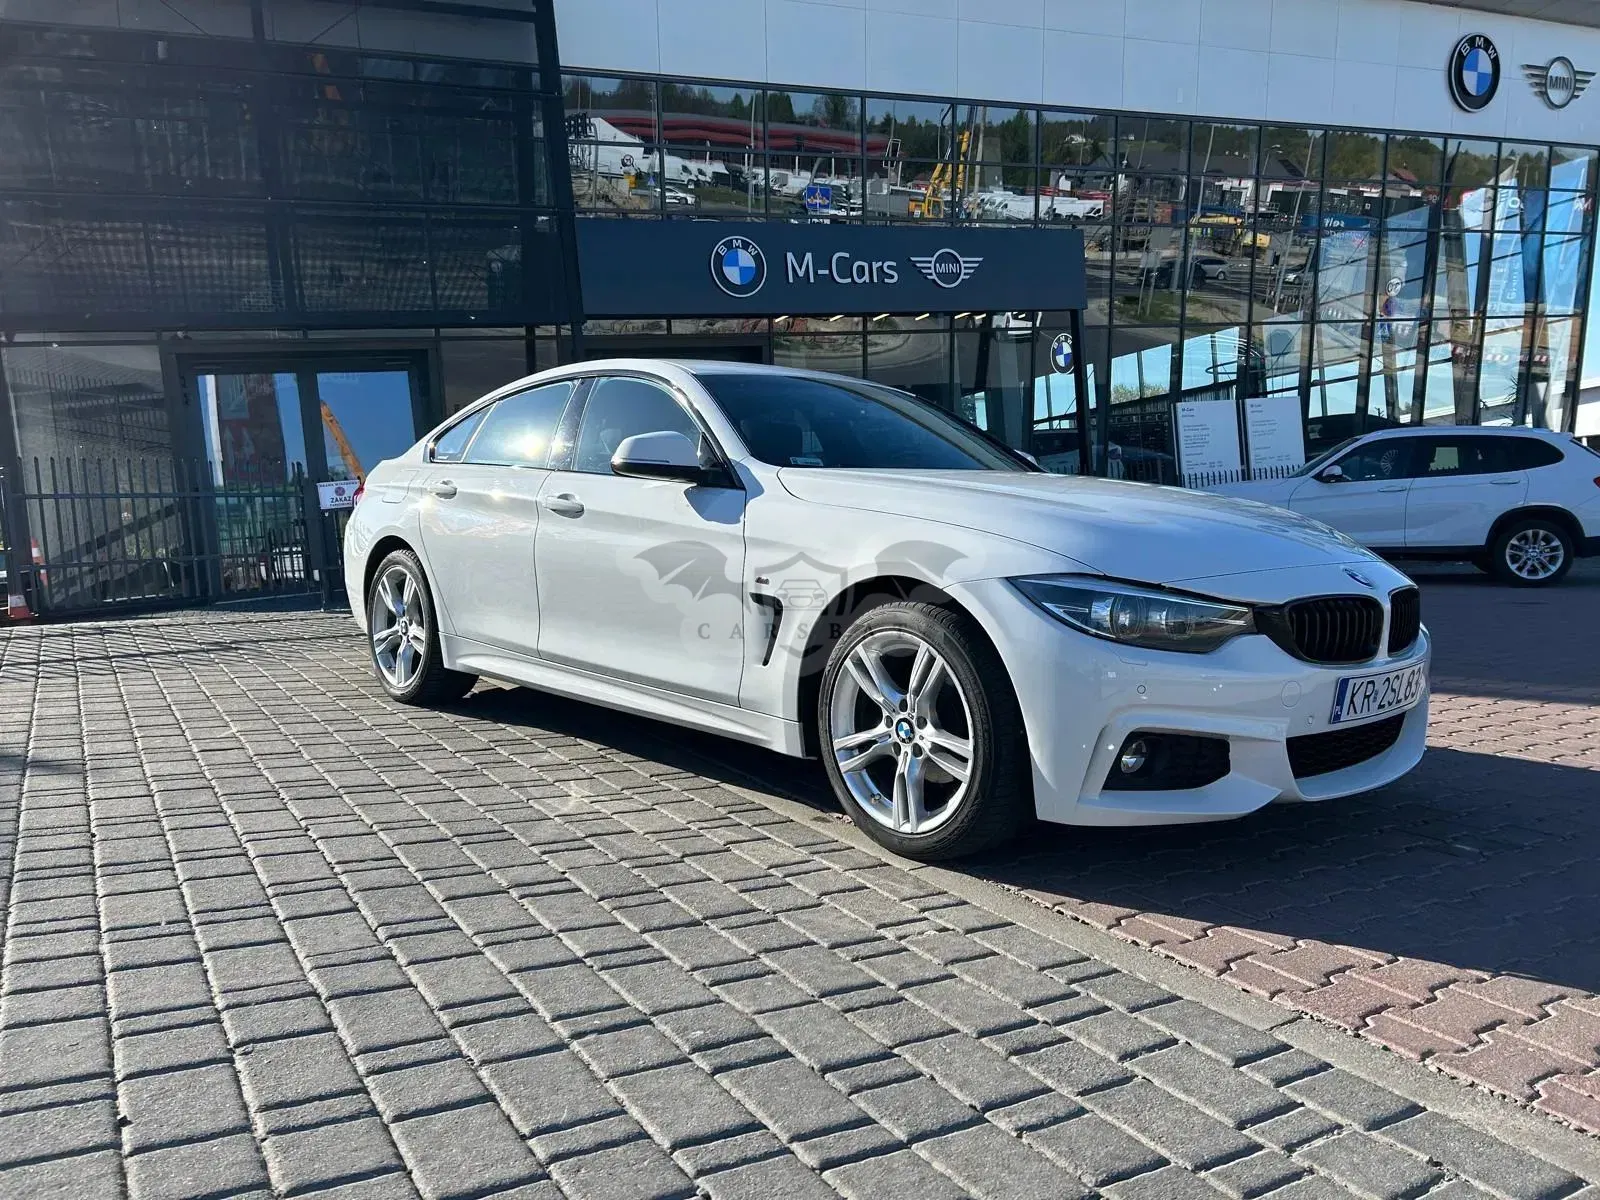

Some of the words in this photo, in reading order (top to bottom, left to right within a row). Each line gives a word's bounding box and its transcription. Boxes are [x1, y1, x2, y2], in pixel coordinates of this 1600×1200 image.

[1460, 36, 1497, 60] BMW
[1550, 75, 1572, 90] MINI
[718, 239, 758, 256] BMW
[786, 251, 899, 284] M-Cars
[936, 262, 960, 274] MINI
[330, 495, 352, 503] ZAKAZ
[1347, 680, 1375, 715] KR
[1377, 666, 1421, 710] 2SL83
